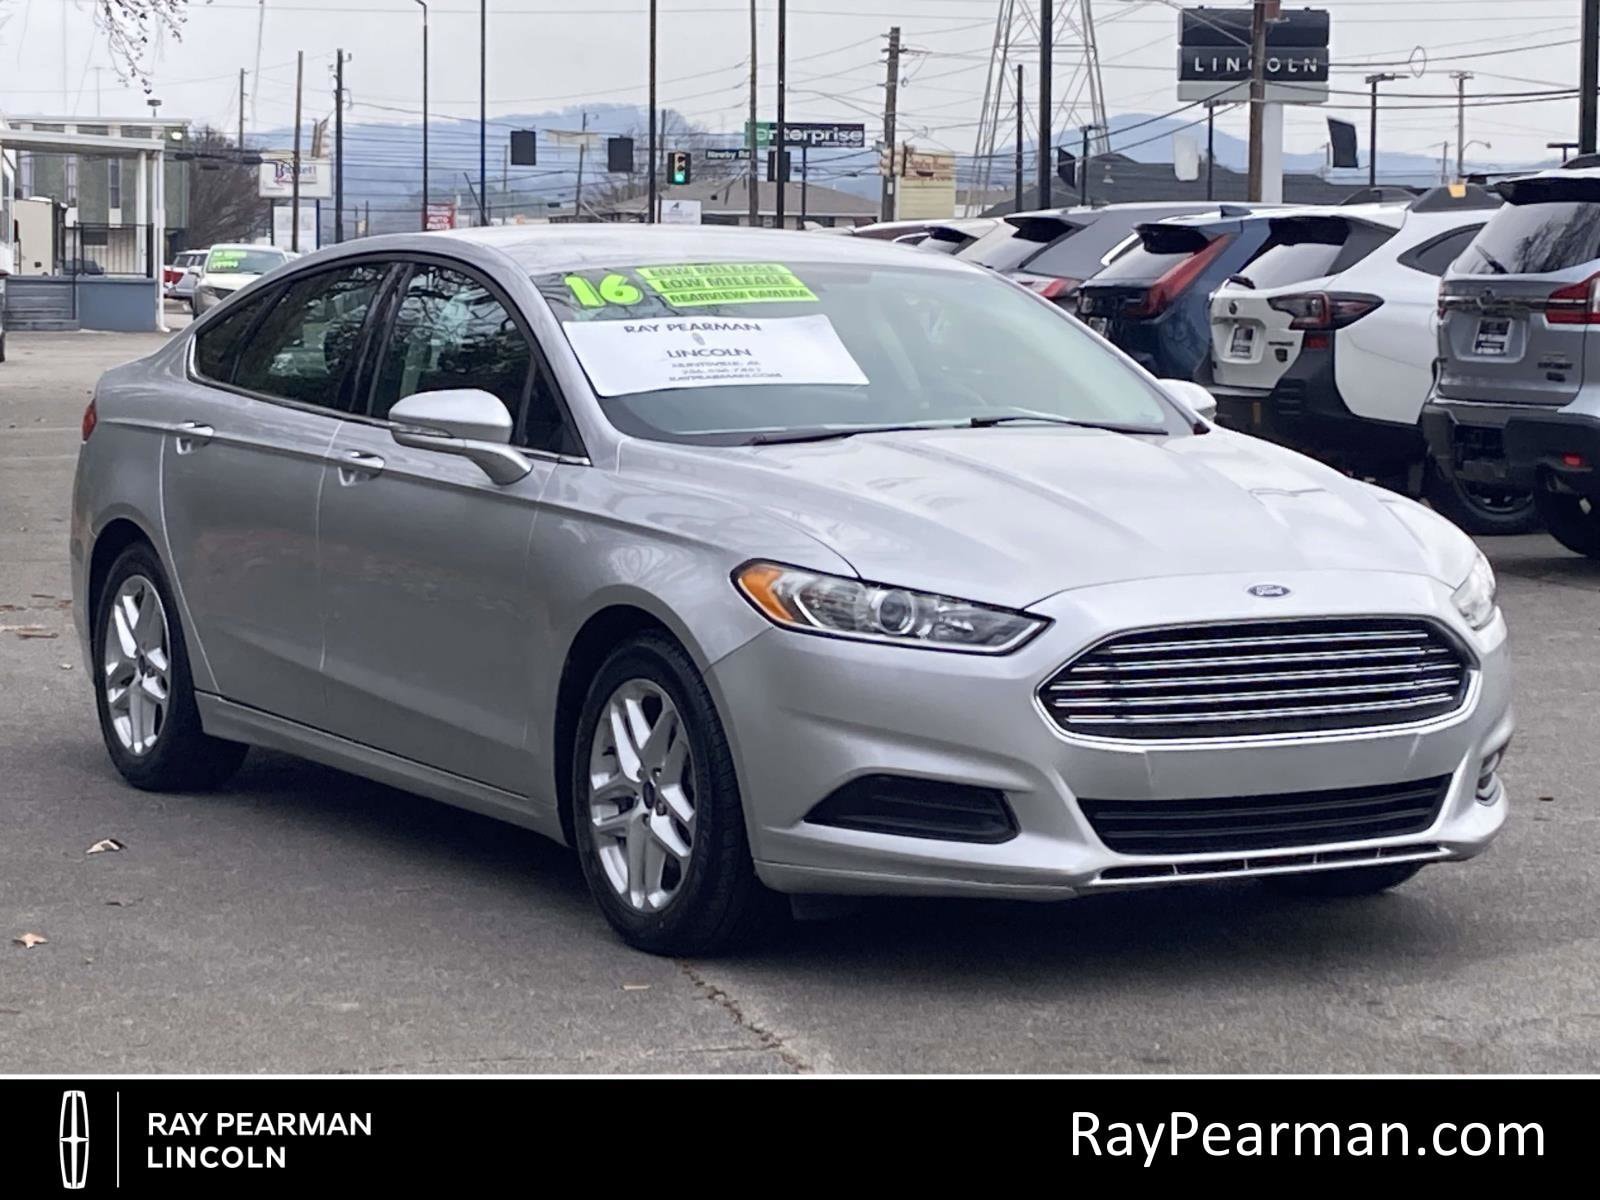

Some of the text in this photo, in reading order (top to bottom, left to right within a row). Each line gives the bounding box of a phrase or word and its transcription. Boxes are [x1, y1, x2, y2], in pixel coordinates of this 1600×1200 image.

[659, 274, 792, 290] LOW MILEAGE
[564, 274, 644, 309] 16
[669, 289, 811, 303] REARVIEW CAMERA
[624, 323, 762, 333] RAY PEARMAN
[666, 348, 752, 358] LINCOLN
